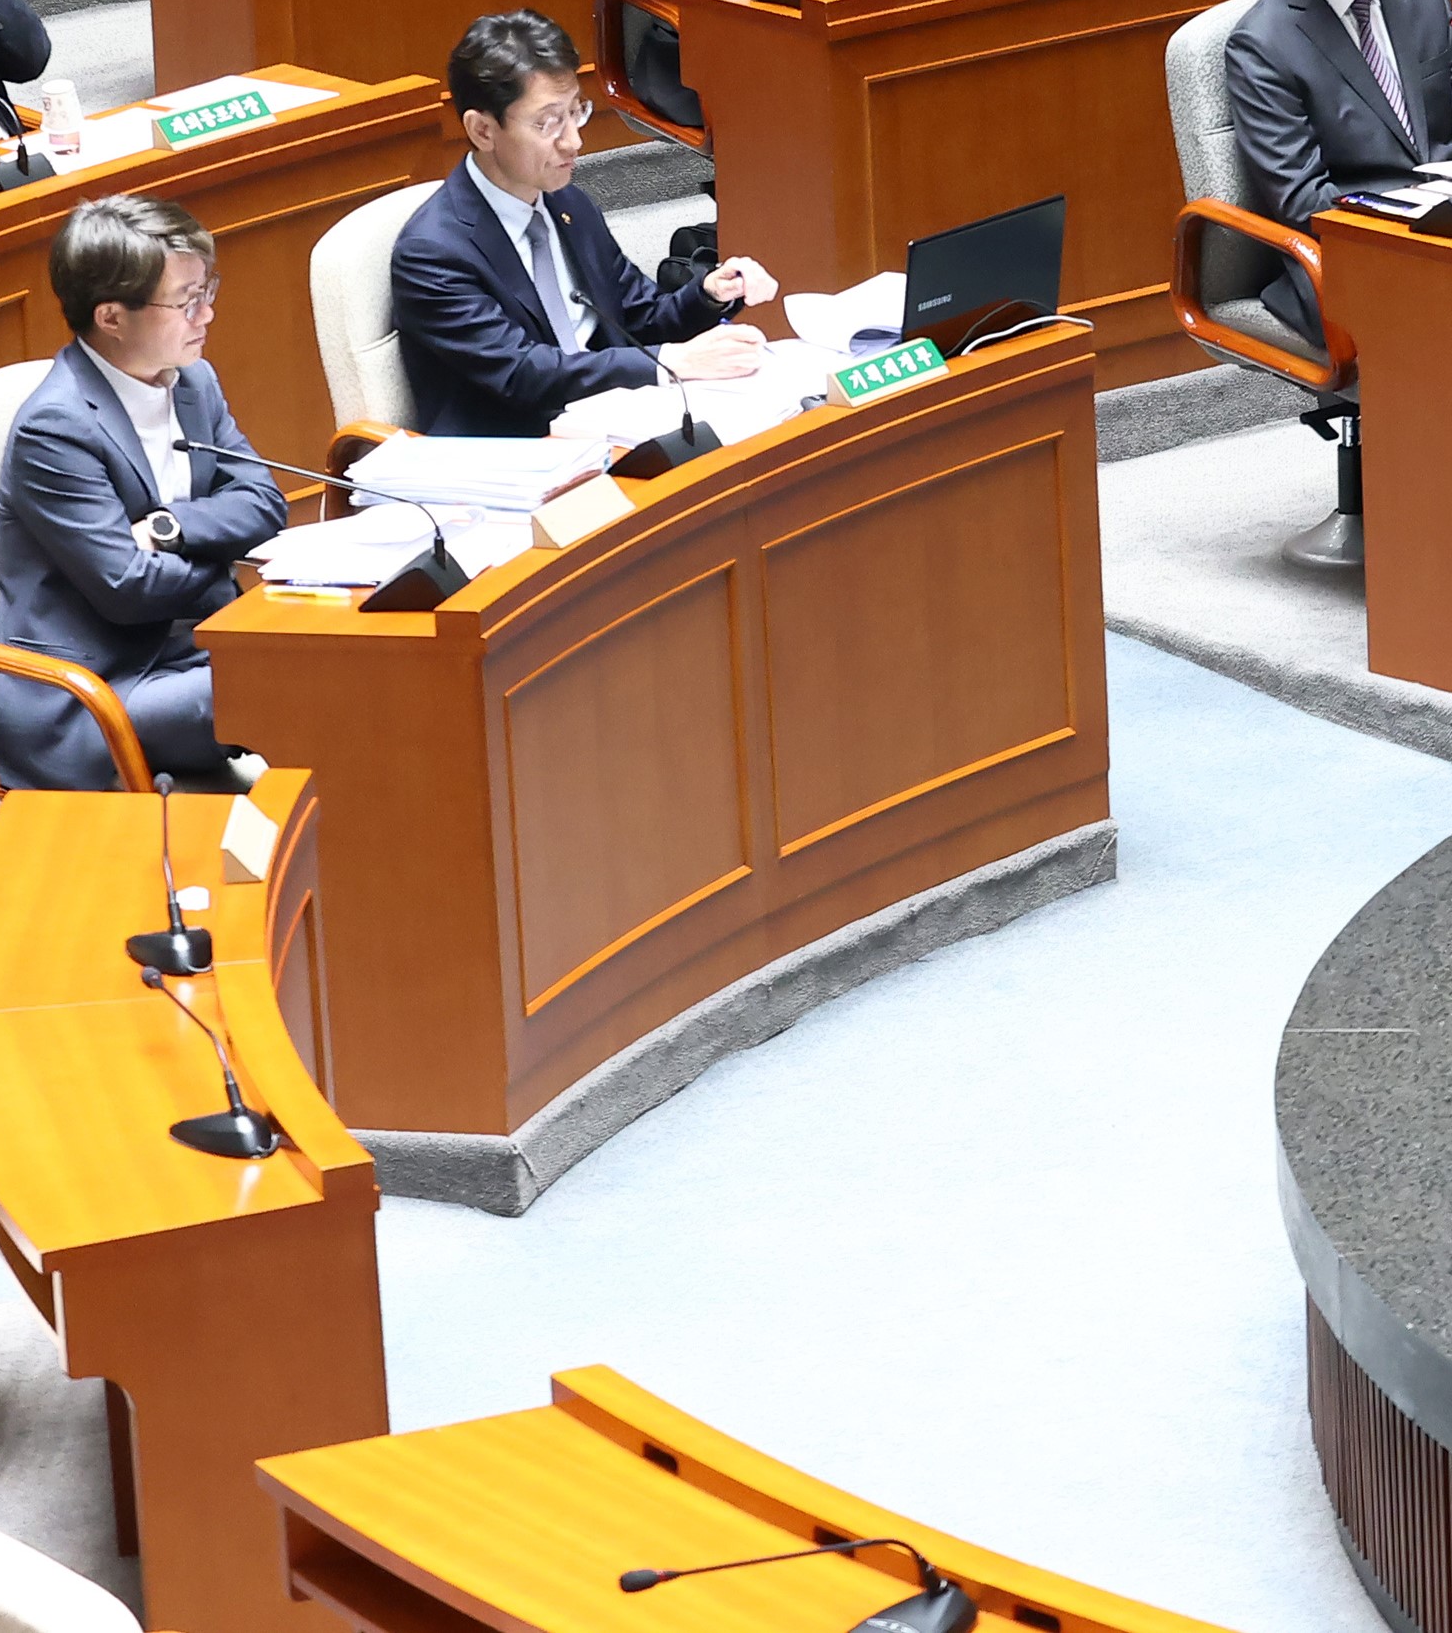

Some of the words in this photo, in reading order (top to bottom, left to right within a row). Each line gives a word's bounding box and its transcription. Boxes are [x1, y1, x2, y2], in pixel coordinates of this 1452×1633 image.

[170, 95, 261, 135] 재외동포청장
[918, 293, 952, 312] SAMSUNG
[848, 346, 933, 390] 기획재정부
